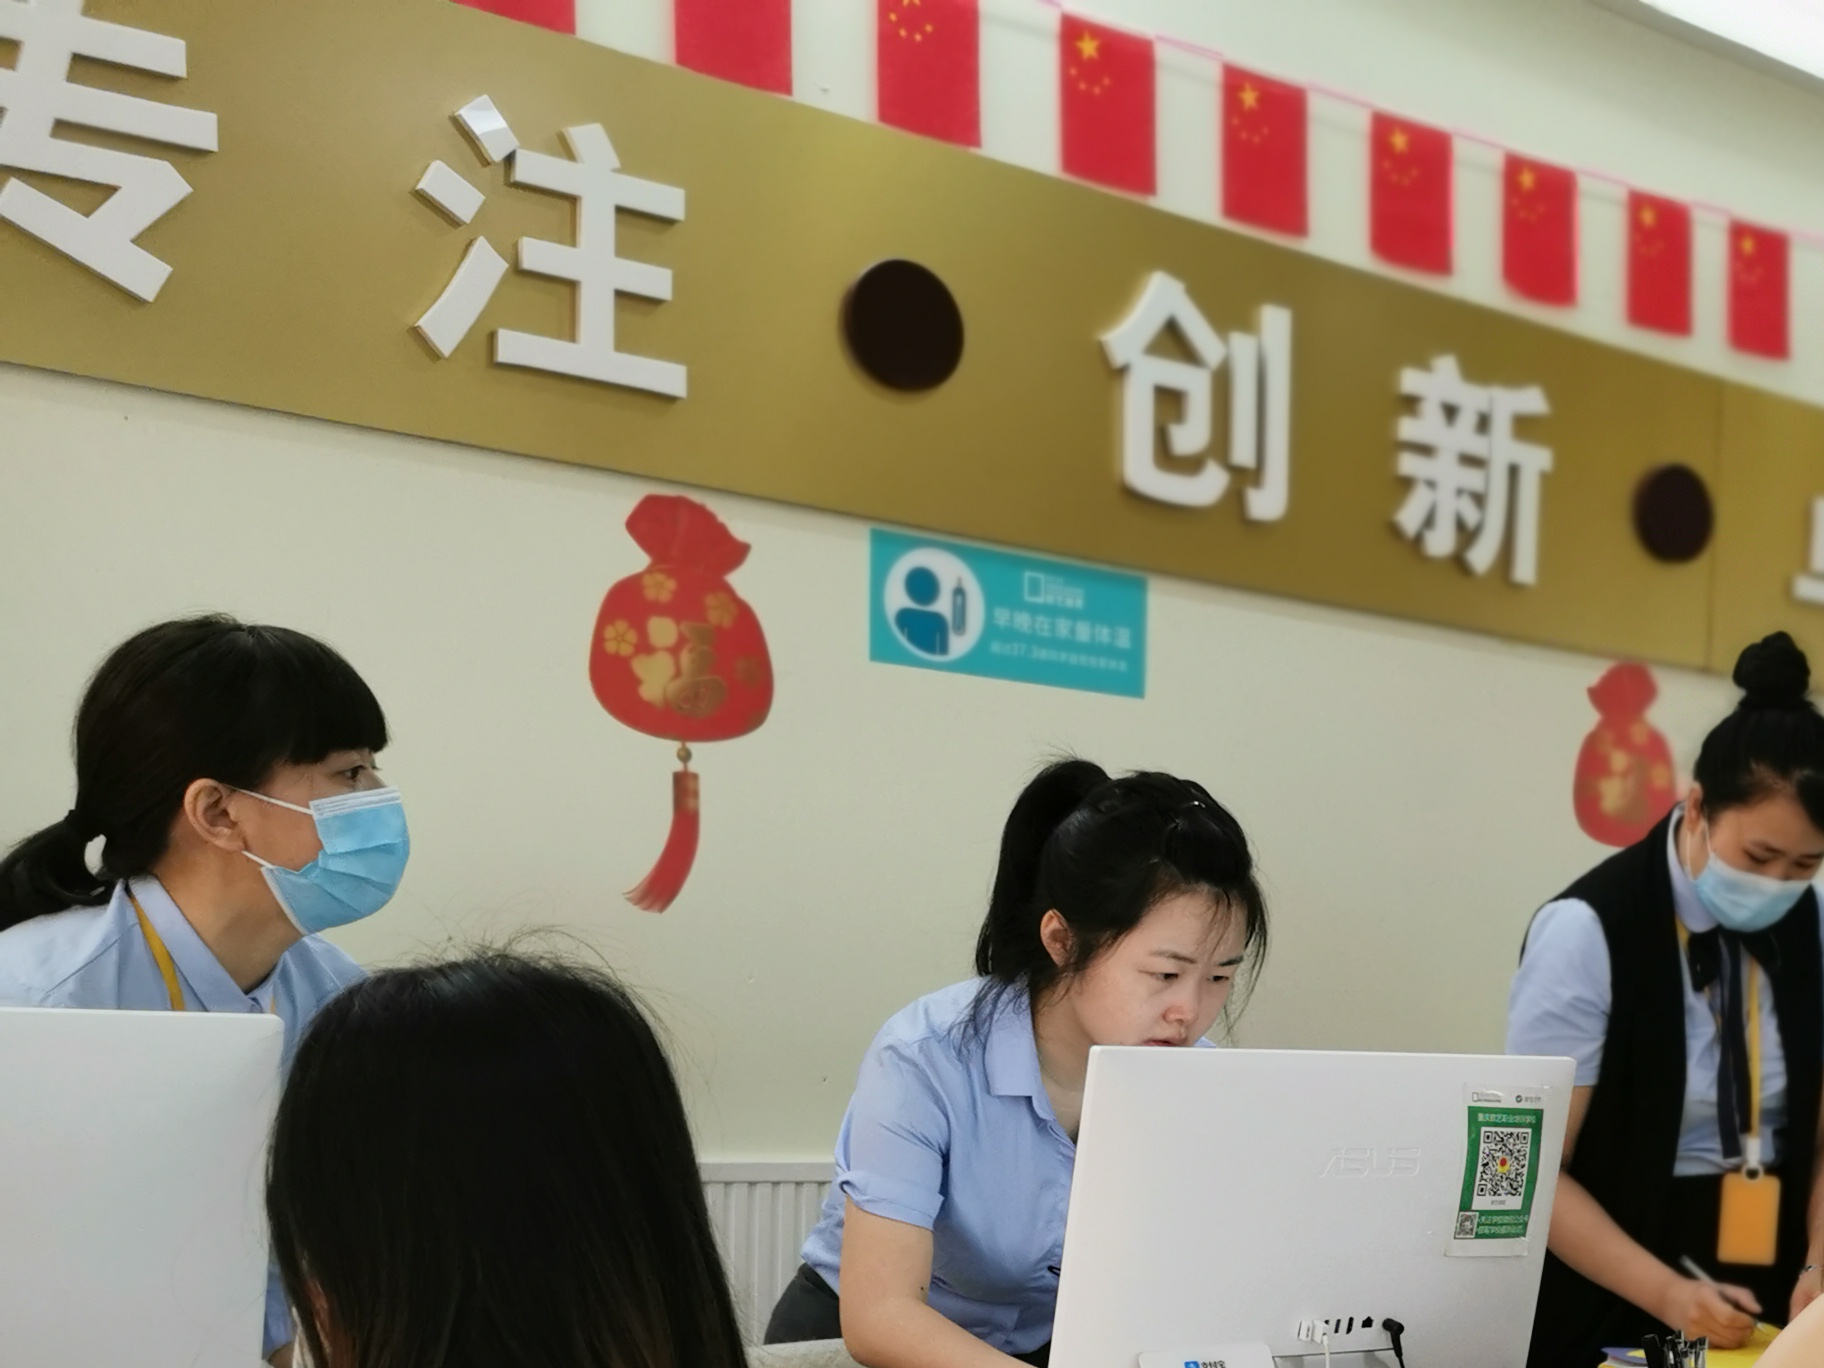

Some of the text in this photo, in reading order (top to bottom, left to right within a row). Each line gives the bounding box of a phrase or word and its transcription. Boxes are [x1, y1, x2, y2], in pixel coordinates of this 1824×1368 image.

[1099, 270, 1553, 587] 创新
[993, 607, 1131, 650] 早晚在家量体温
